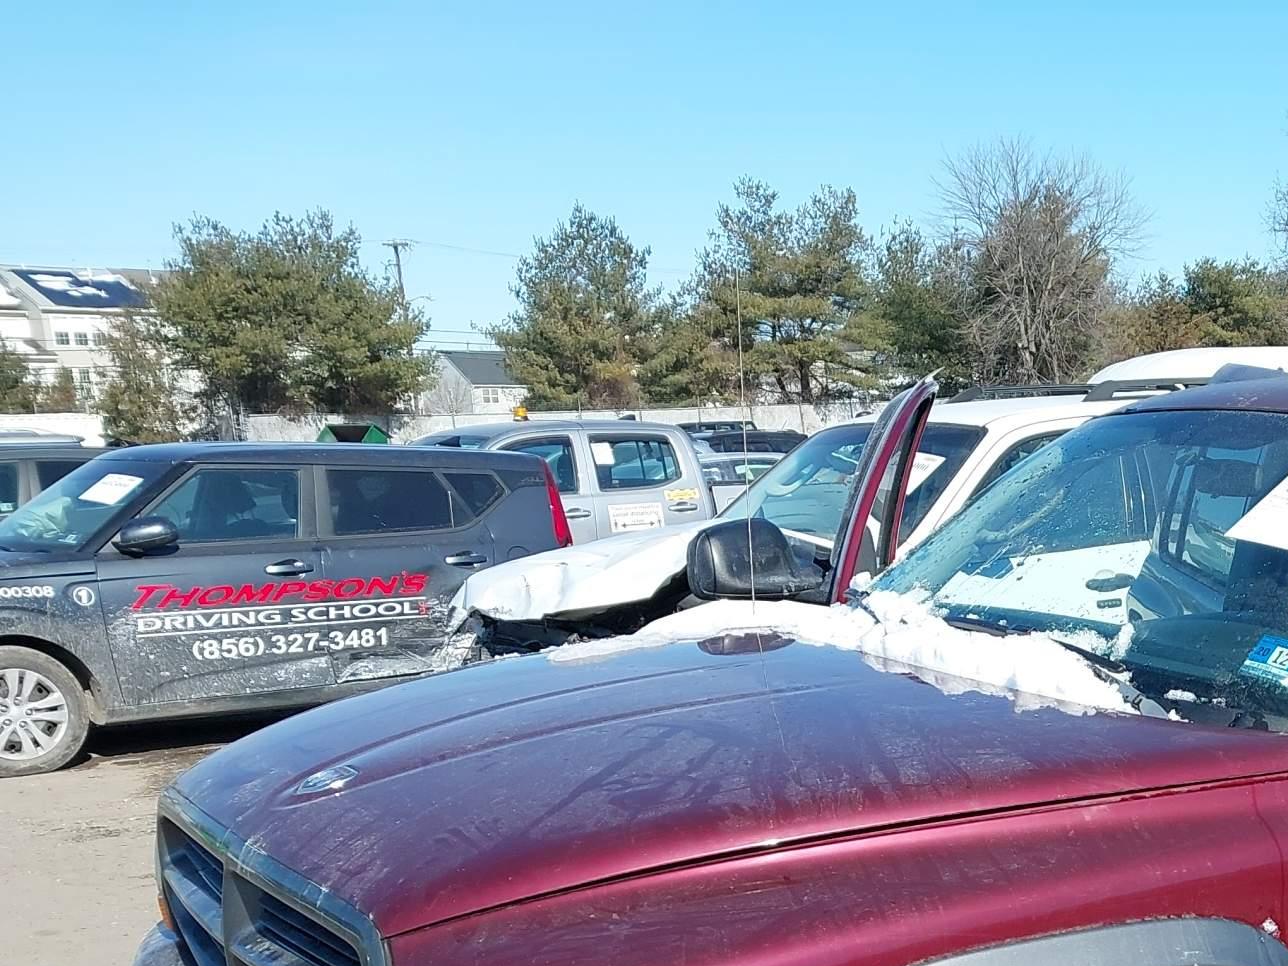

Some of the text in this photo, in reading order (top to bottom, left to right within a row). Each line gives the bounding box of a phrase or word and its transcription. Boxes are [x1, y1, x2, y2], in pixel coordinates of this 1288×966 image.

[132, 570, 429, 610] THOMPSON'S
[136, 607, 281, 632] DRIVING
[290, 601, 419, 622] SCHOOL
[192, 627, 388, 660] (856) 327-3481
